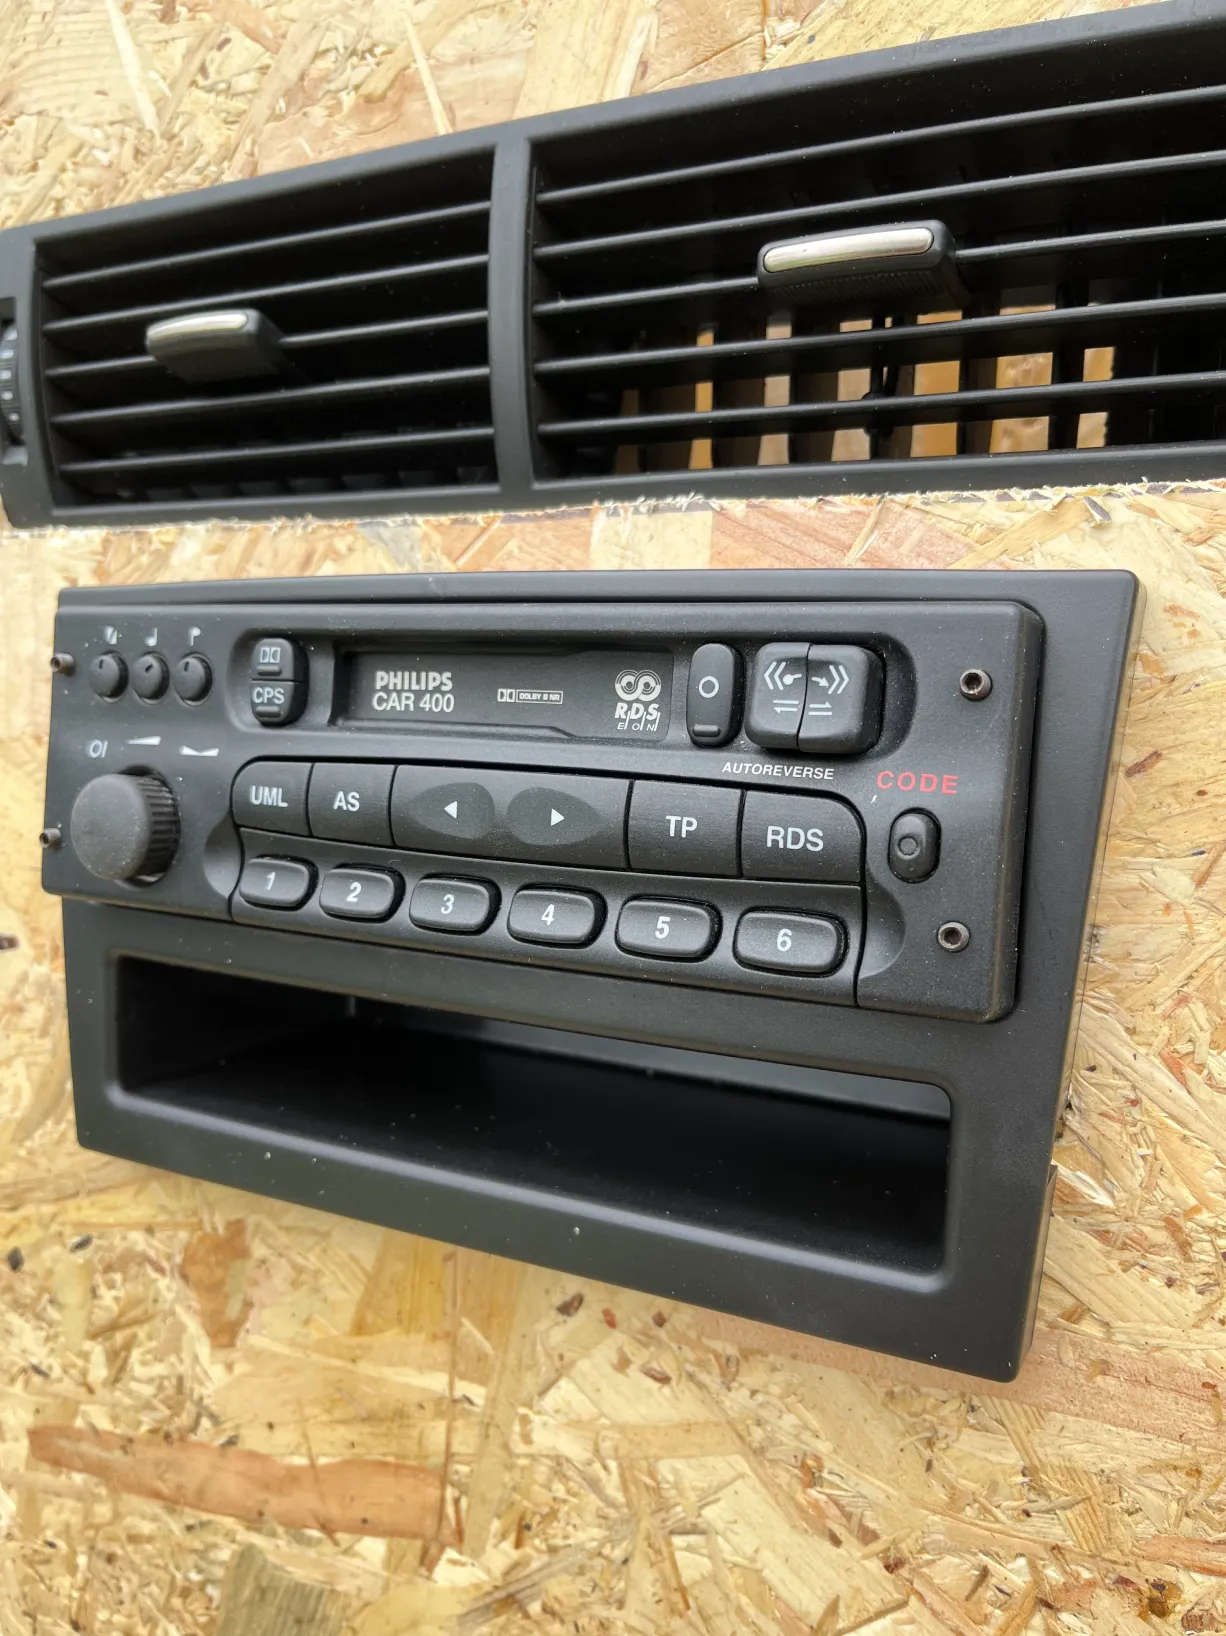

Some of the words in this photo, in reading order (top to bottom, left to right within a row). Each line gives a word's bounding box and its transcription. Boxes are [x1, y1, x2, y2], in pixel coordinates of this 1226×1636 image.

[375, 671, 453, 691] PHILIPS
[253, 687, 285, 704] CPS
[372, 692, 414, 711] CAR
[419, 693, 454, 712] 400
[614, 702, 659, 720] RDS
[722, 762, 834, 780] AUTOREVERSE
[876, 770, 959, 794] CODE
[250, 785, 288, 808] UML
[333, 791, 360, 812] AS
[665, 815, 698, 838] TP
[766, 826, 824, 852] RDS
[265, 871, 276, 891] 1
[346, 882, 362, 903] 2
[440, 894, 455, 914] 3
[541, 904, 555, 926] 4
[655, 916, 671, 939] 5
[776, 929, 793, 952] 6
